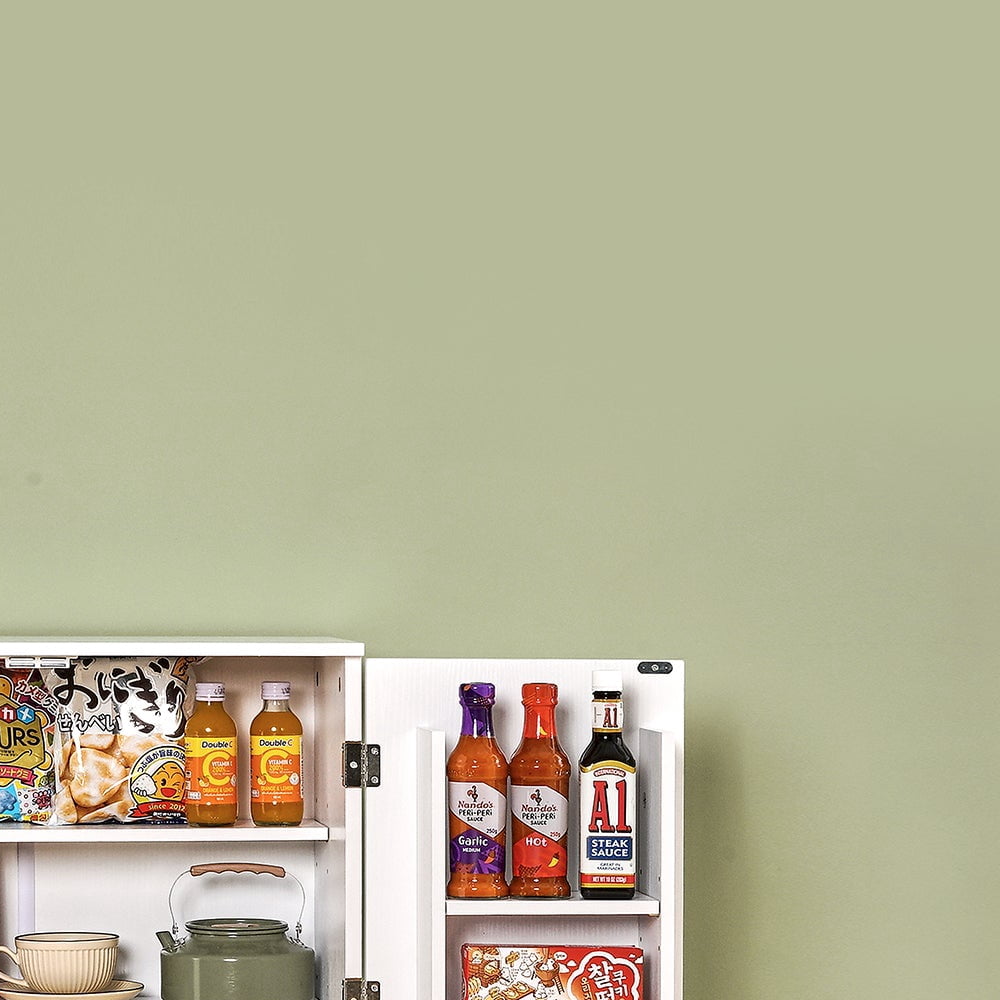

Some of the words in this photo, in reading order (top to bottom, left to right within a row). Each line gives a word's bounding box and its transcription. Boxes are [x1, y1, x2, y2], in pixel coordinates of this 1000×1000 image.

[259, 739, 287, 747] Double
[458, 800, 494, 809] Nando's
[521, 804, 557, 813] Nando's
[458, 835, 489, 846] Garlic
[591, 839, 629, 848] STEAK
[591, 848, 629, 857] SAUCE
